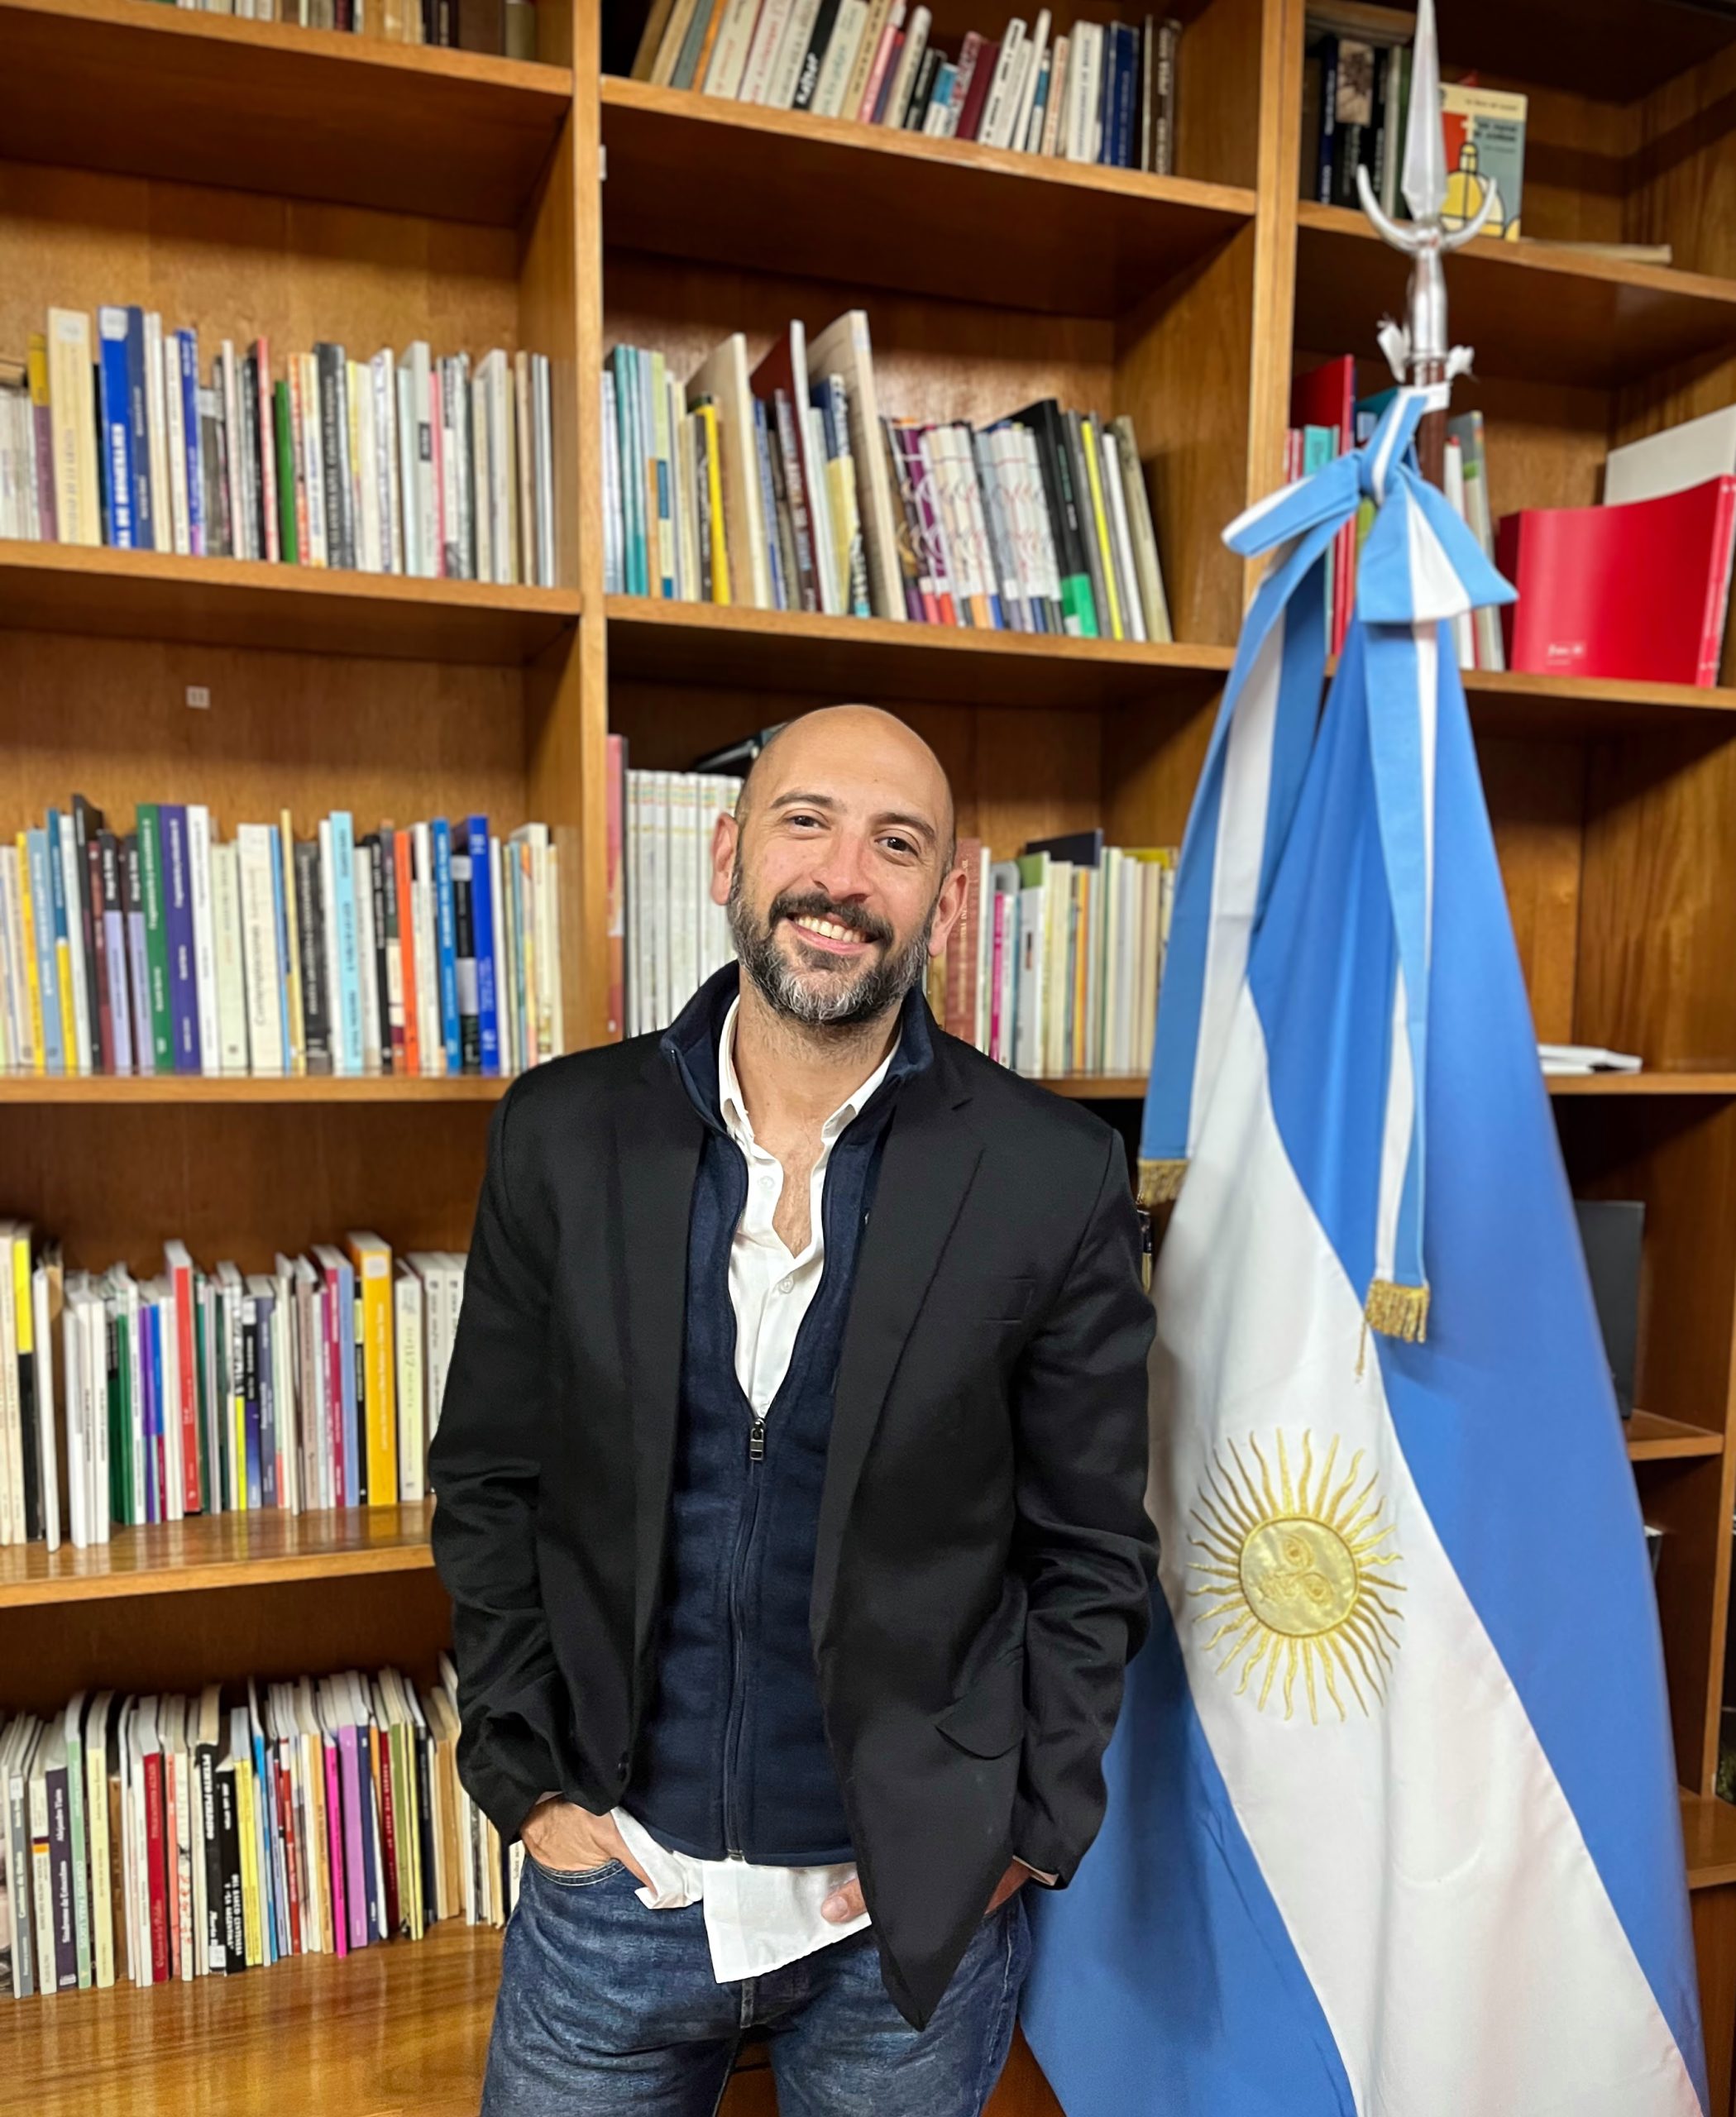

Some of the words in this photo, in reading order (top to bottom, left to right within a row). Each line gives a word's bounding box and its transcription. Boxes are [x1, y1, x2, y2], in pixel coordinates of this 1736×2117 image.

[202, 1753, 213, 1793] PUERTO
[79, 1899, 88, 1919] PARA
[232, 1890, 242, 1916] BARCO
